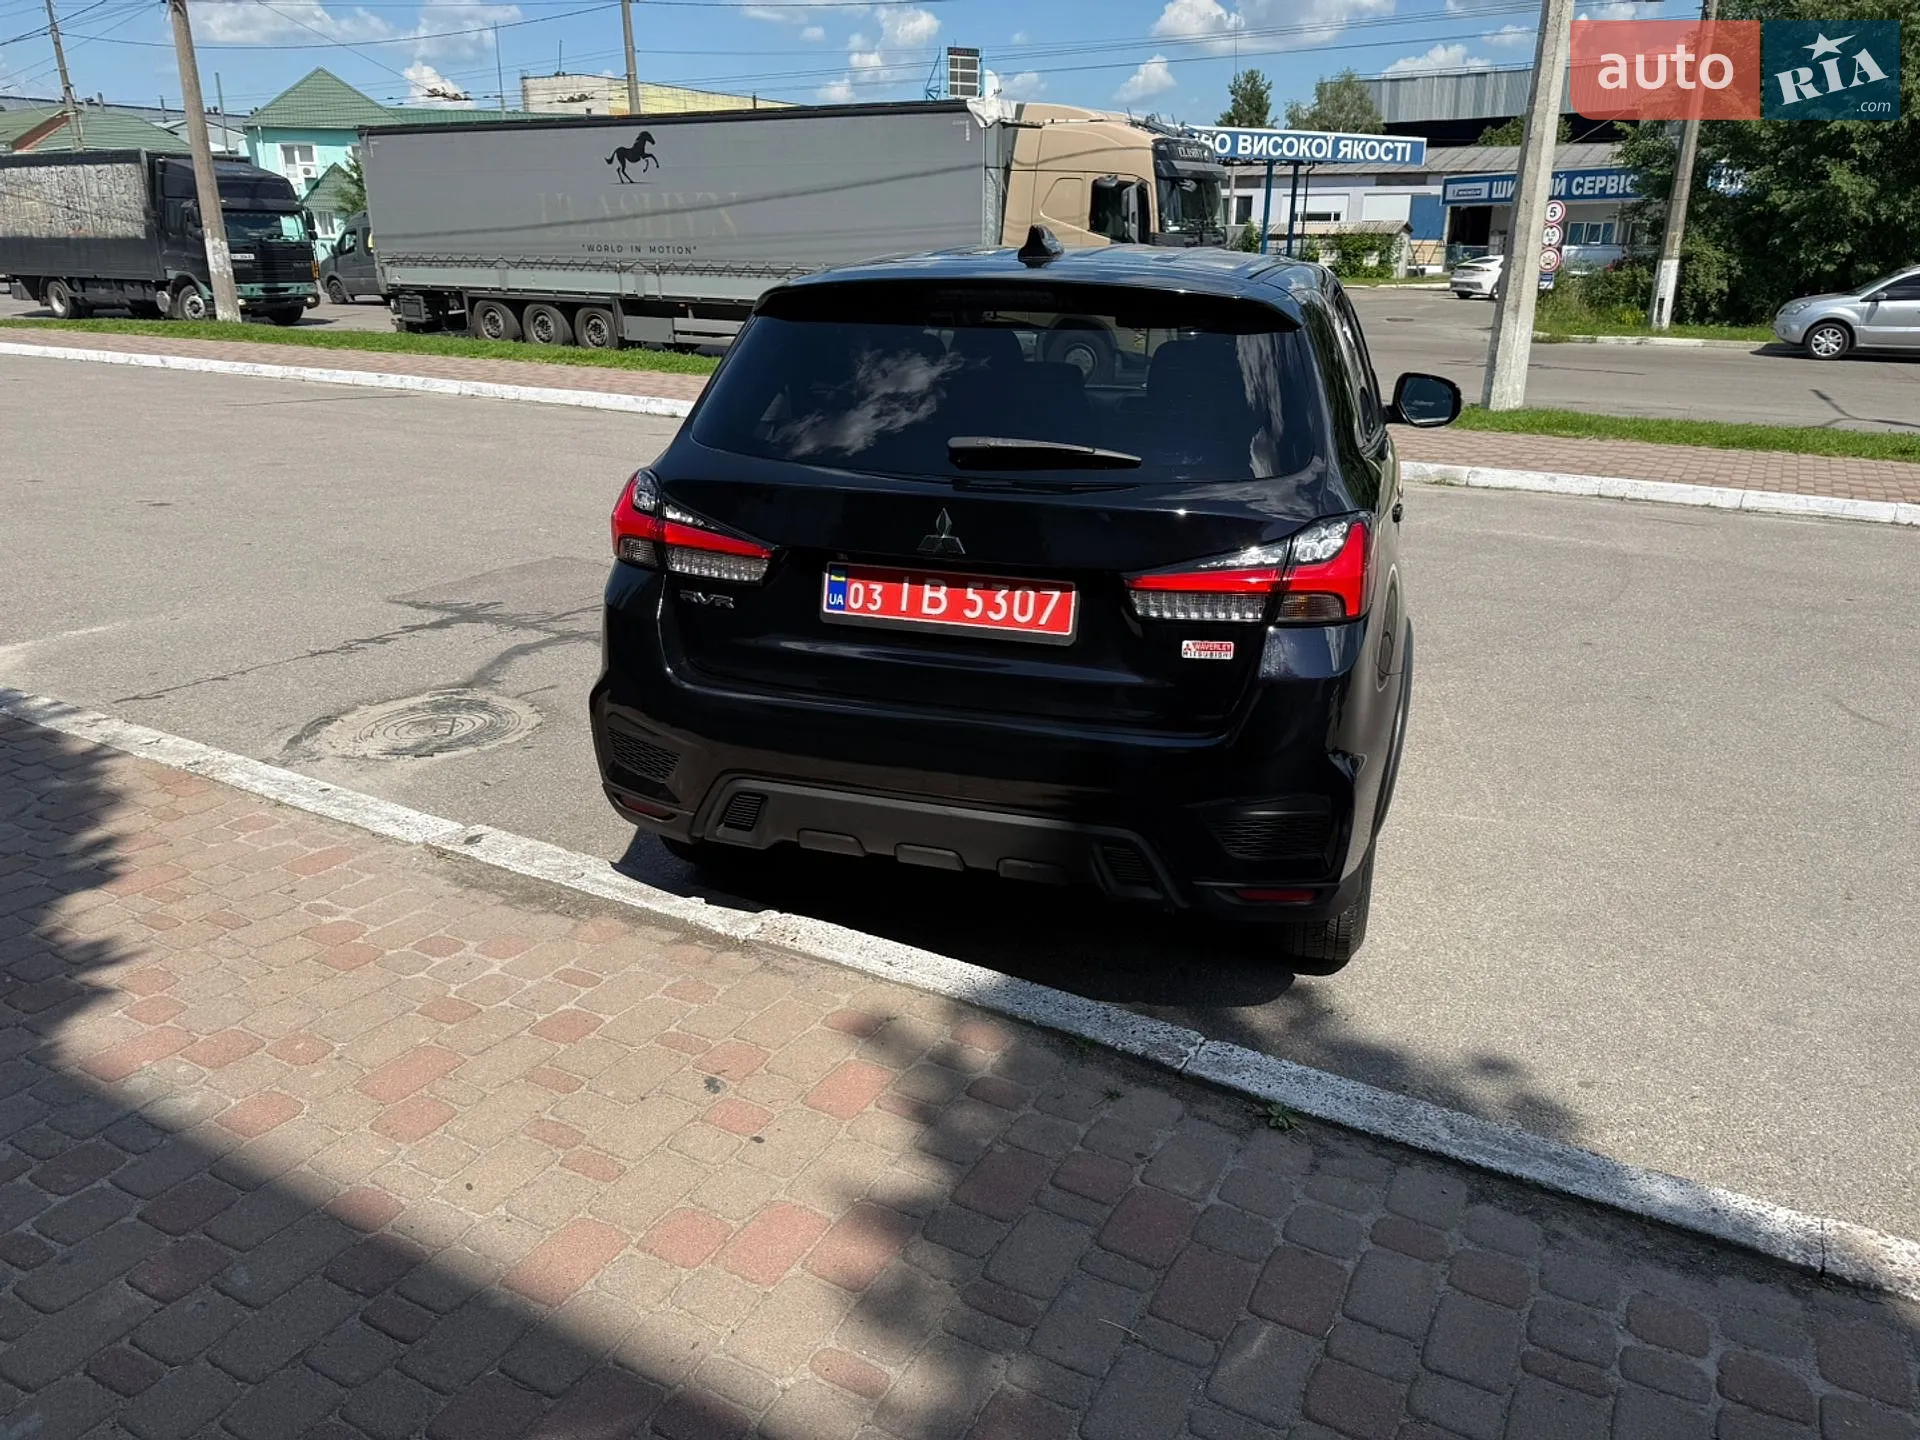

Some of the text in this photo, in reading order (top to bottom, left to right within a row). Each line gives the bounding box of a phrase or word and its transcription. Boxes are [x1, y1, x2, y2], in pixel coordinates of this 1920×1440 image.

[1236, 133, 1335, 159] ВИСОКОЇ
[1337, 139, 1412, 162] ЯКОСТІ
[1549, 206, 1558, 219] 5
[581, 243, 698, 255] "WORLD IN MOTION"
[679, 589, 736, 609] RVR
[828, 592, 845, 606] UA
[848, 576, 1062, 626] 03 IB 5307
